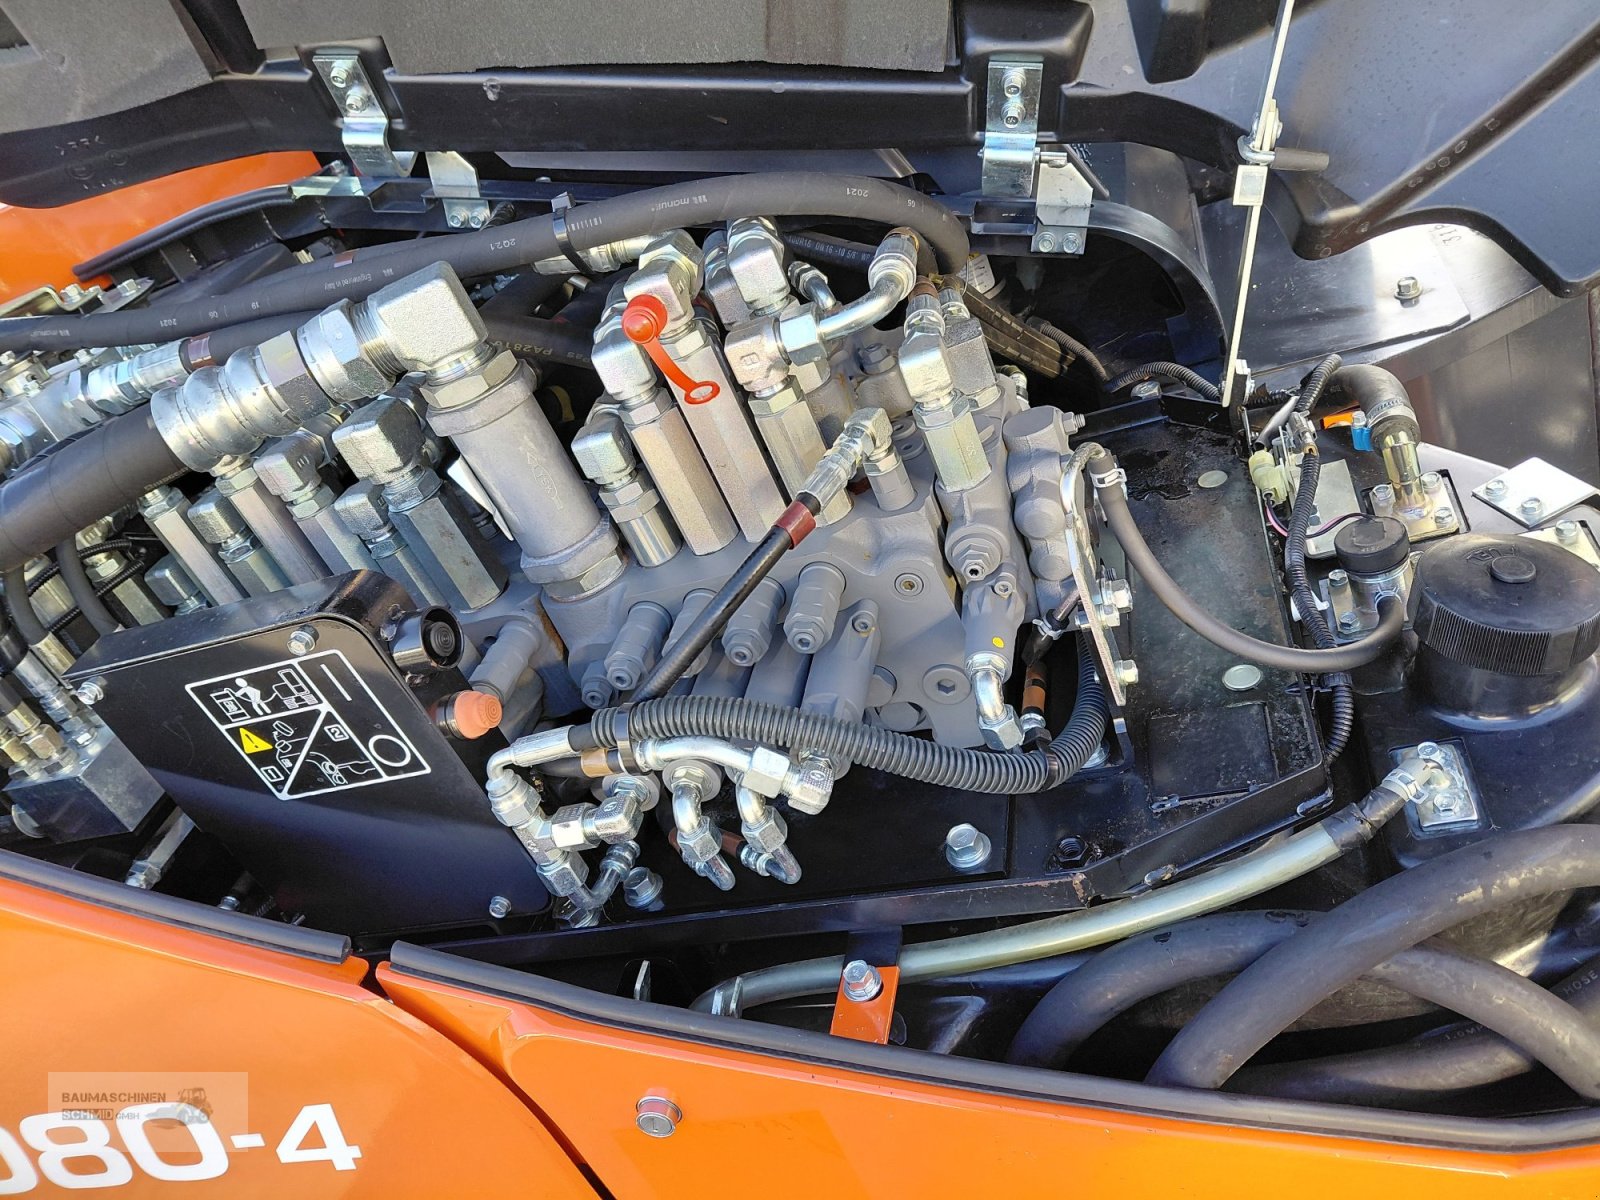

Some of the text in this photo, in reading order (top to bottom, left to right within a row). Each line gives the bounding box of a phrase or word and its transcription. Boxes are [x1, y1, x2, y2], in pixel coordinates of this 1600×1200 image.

[845, 186, 869, 198] 2021
[159, 318, 177, 327] 2021
[1563, 970, 1599, 995] HOSE
